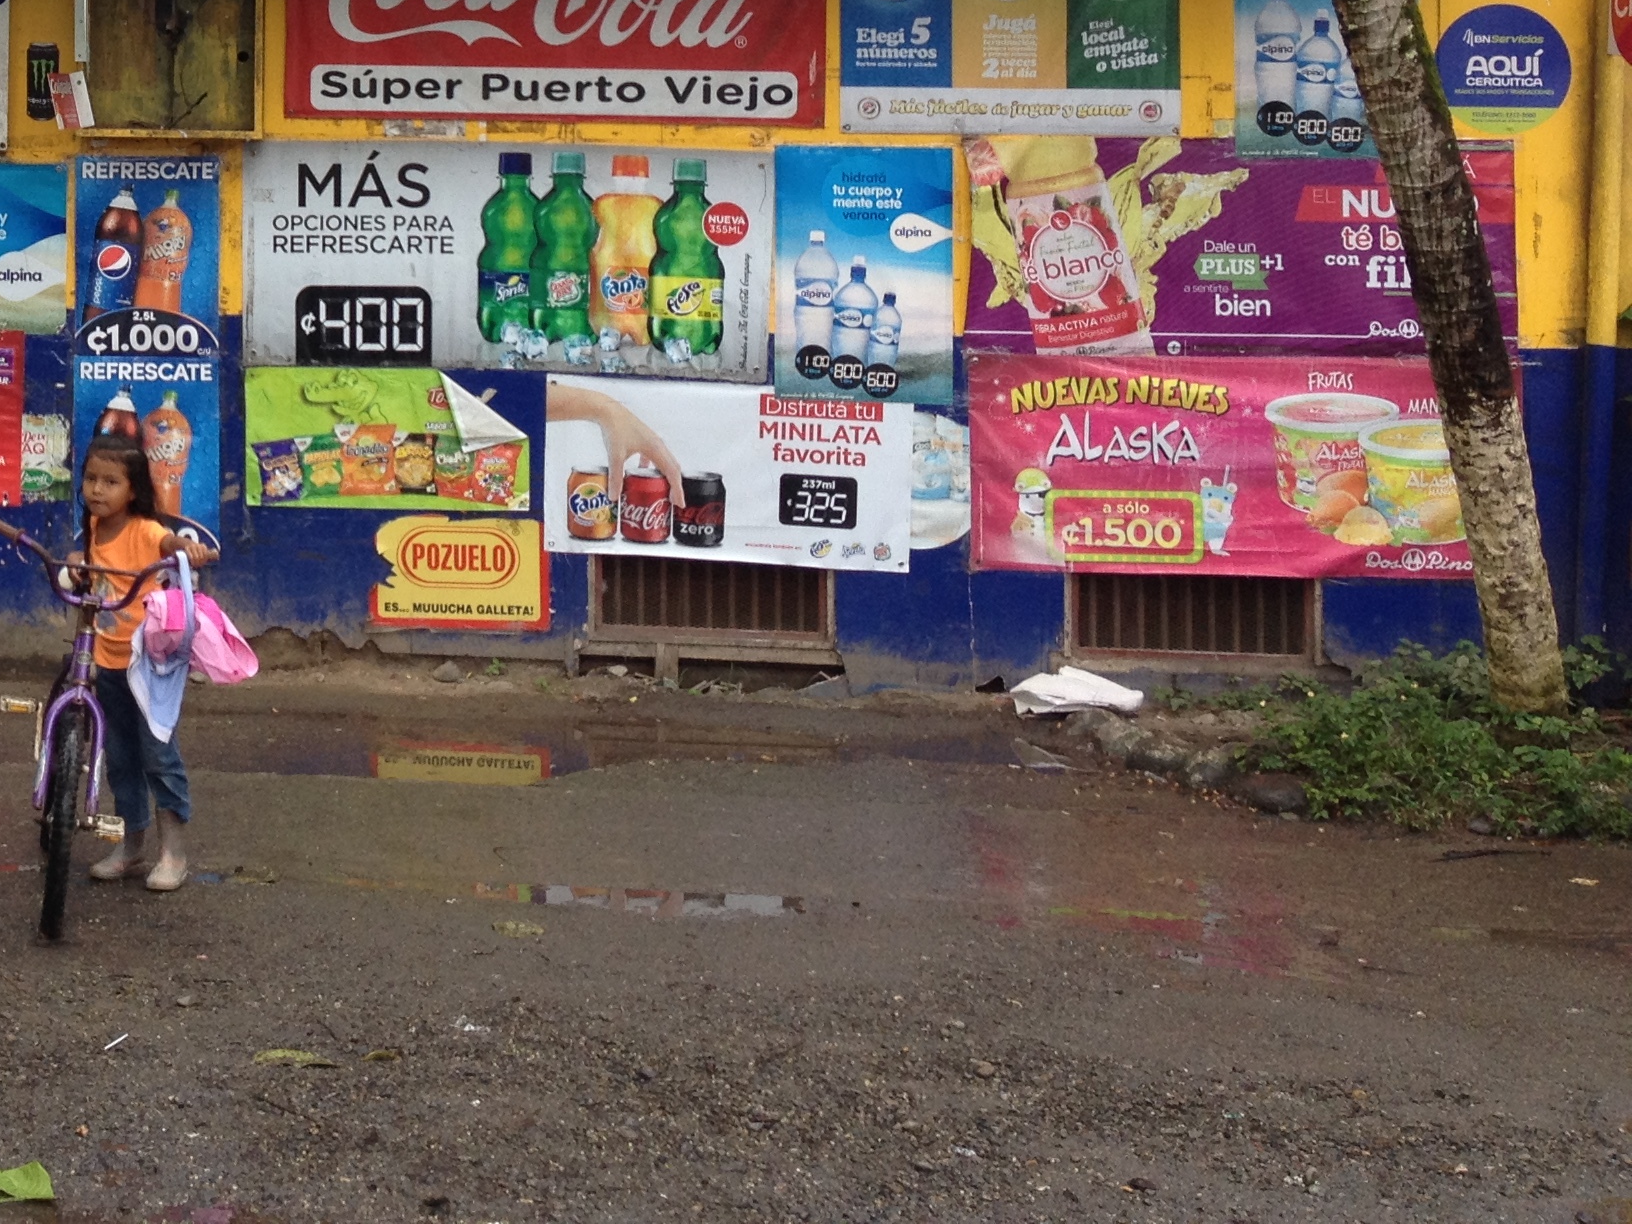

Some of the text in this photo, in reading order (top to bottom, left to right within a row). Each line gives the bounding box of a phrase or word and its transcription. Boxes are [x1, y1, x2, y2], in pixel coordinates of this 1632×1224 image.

[910, 16, 932, 45] 5
[983, 13, 1037, 34] Jugá
[1081, 25, 1125, 46] local
[856, 44, 938, 60] números
[1084, 37, 1149, 61] empate
[981, 58, 1000, 79] 2
[1096, 51, 1159, 73] o visita
[1466, 48, 1544, 77] AQUÍ
[320, 68, 794, 112] Súper Puerto Viejo
[1466, 77, 1543, 87] CERQUITICA
[889, 98, 1133, 119] Más fáciles de jugar ganar
[82, 162, 214, 180] REFRESCATE
[297, 150, 430, 208] MÁS
[841, 171, 887, 184] hidratá
[832, 184, 903, 200] tu cuerpo y
[1312, 188, 1336, 204] EL
[832, 197, 902, 209] mente este
[272, 214, 454, 233] OPCIONES PARA
[708, 215, 747, 227] NUEVA
[709, 223, 744, 235] 355ML
[894, 225, 932, 238] alpina
[1342, 225, 1373, 251] té
[272, 235, 455, 255] REFRESCARTE
[1204, 240, 1257, 254] Dale un
[1042, 248, 1125, 280] blanco
[1200, 253, 1284, 276] PLUS +1
[1324, 254, 1360, 266] con
[496, 283, 528, 302] Sprite
[600, 273, 648, 298] Fanta
[800, 287, 832, 301] alpina
[1192, 282, 1230, 294] sentirte
[1215, 294, 1271, 318] bien
[300, 297, 425, 352] ¢400
[1058, 317, 1099, 332] ACTIVA
[87, 324, 199, 356] ¢1.000
[80, 362, 213, 382] REFRESCATE
[1308, 371, 1353, 391] FRUTAS
[1010, 375, 1120, 415] NUEVAS
[854, 403, 876, 419] tu
[758, 420, 882, 446] MINILATA
[772, 443, 867, 467] favorita
[802, 478, 836, 490] 237ml
[569, 489, 611, 516] Fanta
[1103, 499, 1150, 515] a sólo
[680, 522, 715, 536] zero
[1061, 518, 1183, 548] ¢1.500
[412, 542, 506, 572] POZUELO
[1366, 551, 1401, 569] Dos
[413, 602, 534, 616] MUUUCHA GALLETA!
